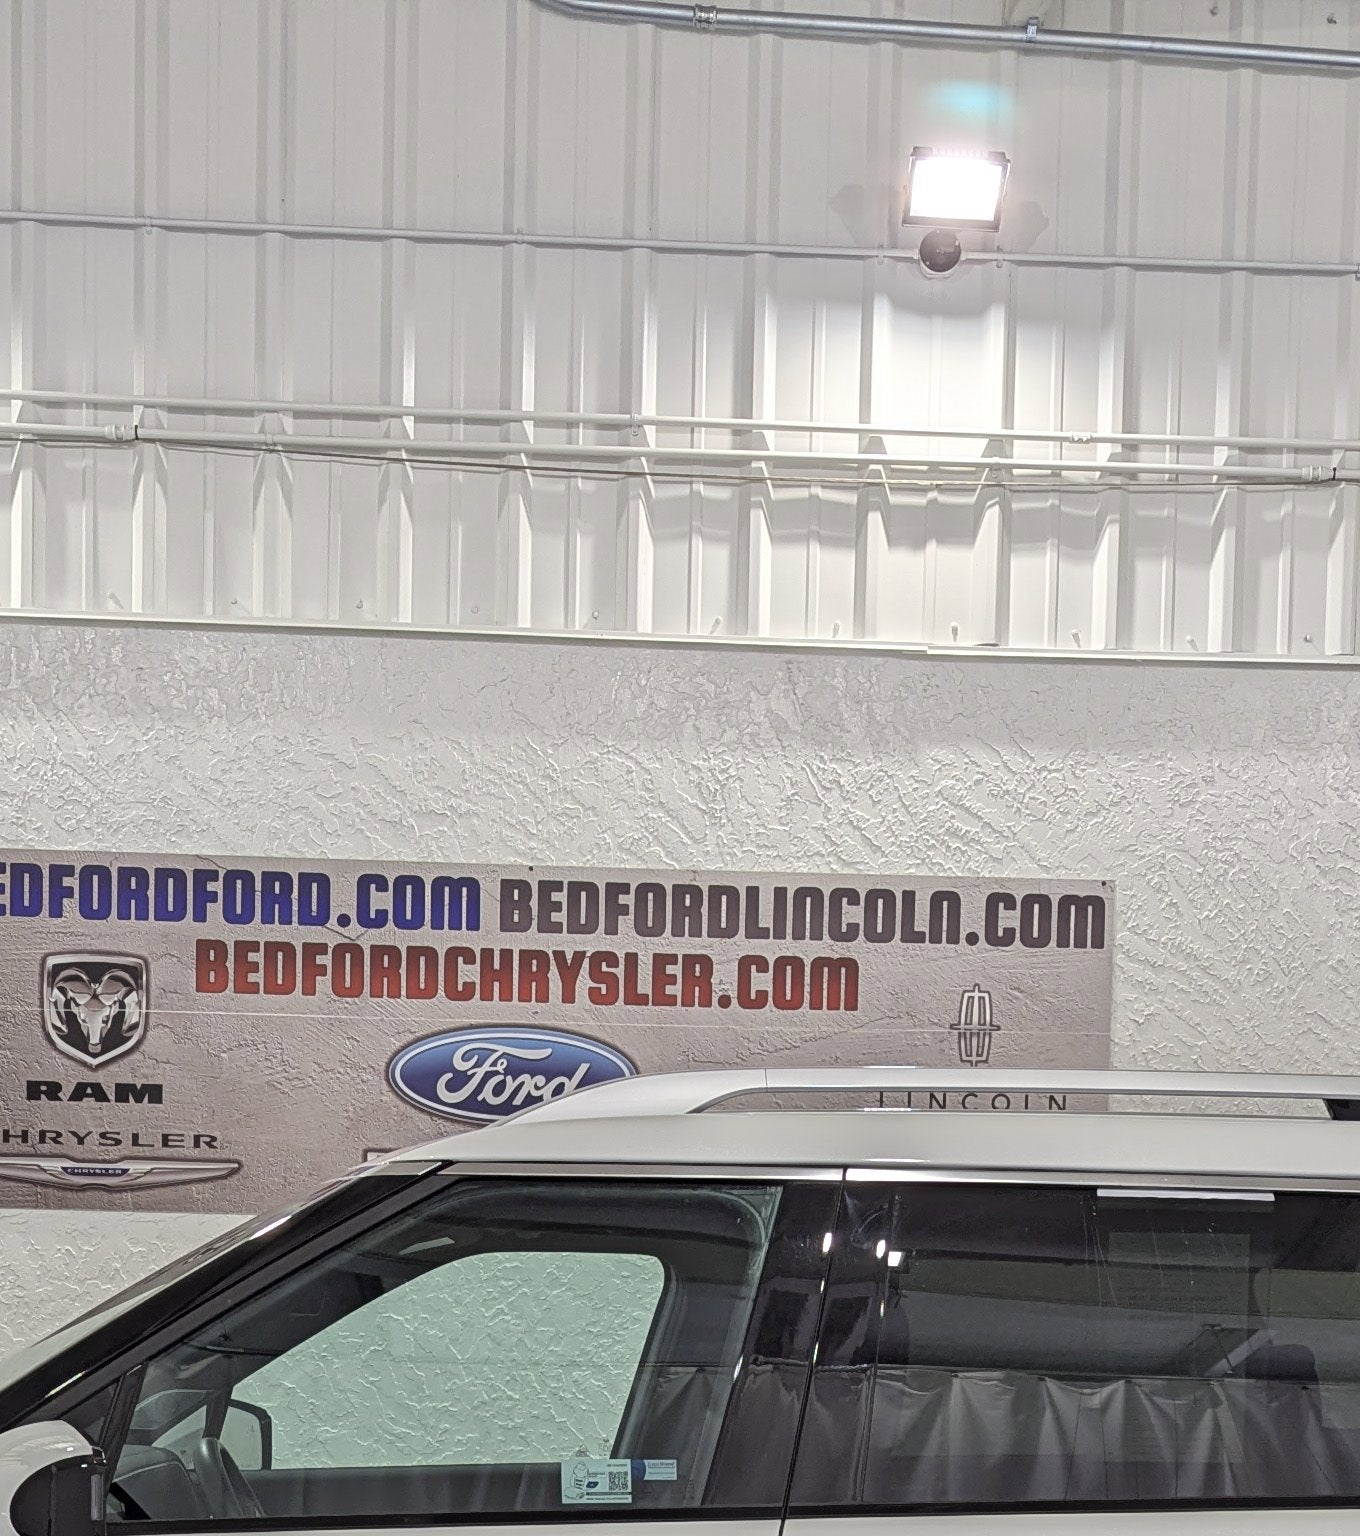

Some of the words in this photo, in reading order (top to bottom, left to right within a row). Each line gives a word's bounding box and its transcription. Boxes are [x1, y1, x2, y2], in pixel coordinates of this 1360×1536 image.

[499, 878, 1106, 950] BEDFORDLINCOLN.COM
[195, 938, 860, 1012] BEDFORDCHRYSLER.COM
[26, 1080, 164, 1105] RAM
[436, 1042, 591, 1106] Ford
[67, 1167, 122, 1175] CHRYSLER
